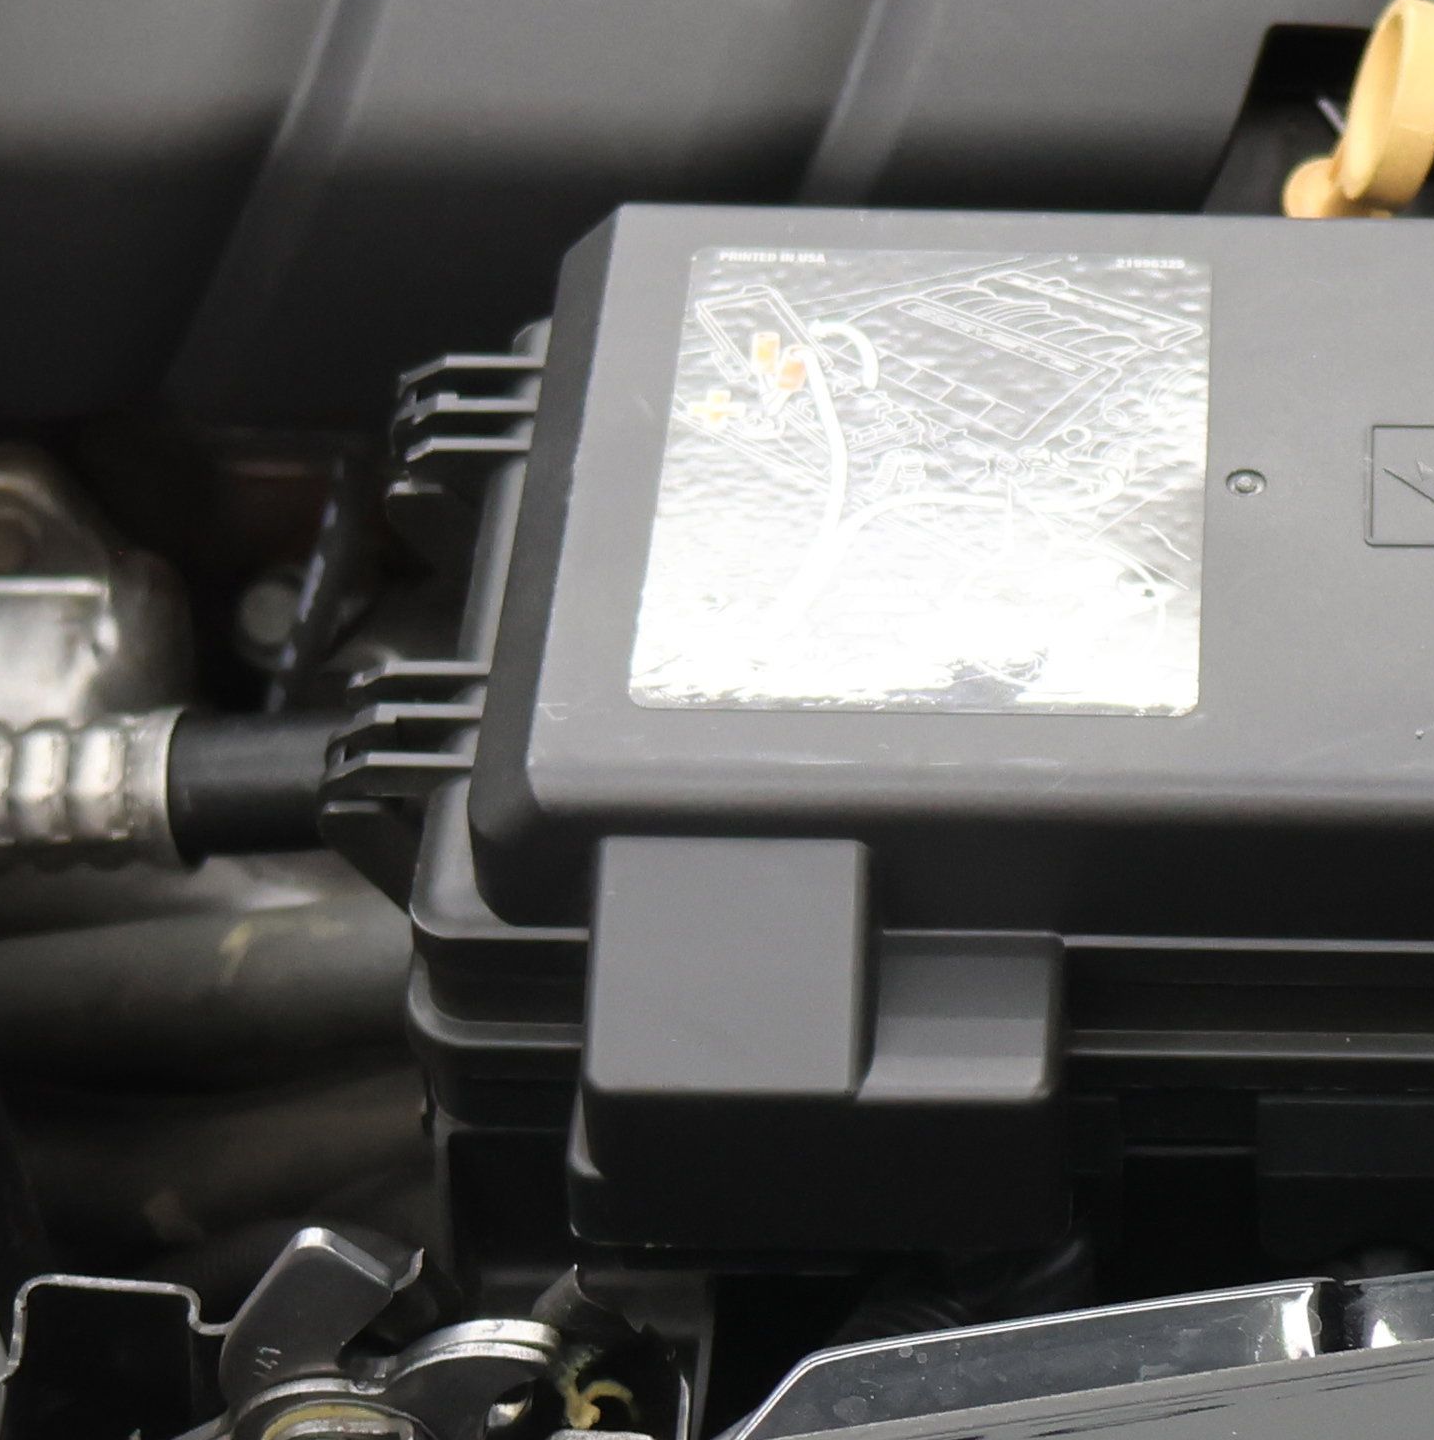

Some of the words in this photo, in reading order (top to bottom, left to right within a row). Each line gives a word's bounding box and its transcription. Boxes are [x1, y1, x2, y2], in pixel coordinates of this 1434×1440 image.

[718, 251, 776, 265] PRINTED
[779, 251, 795, 265] IN
[797, 252, 826, 266] USA
